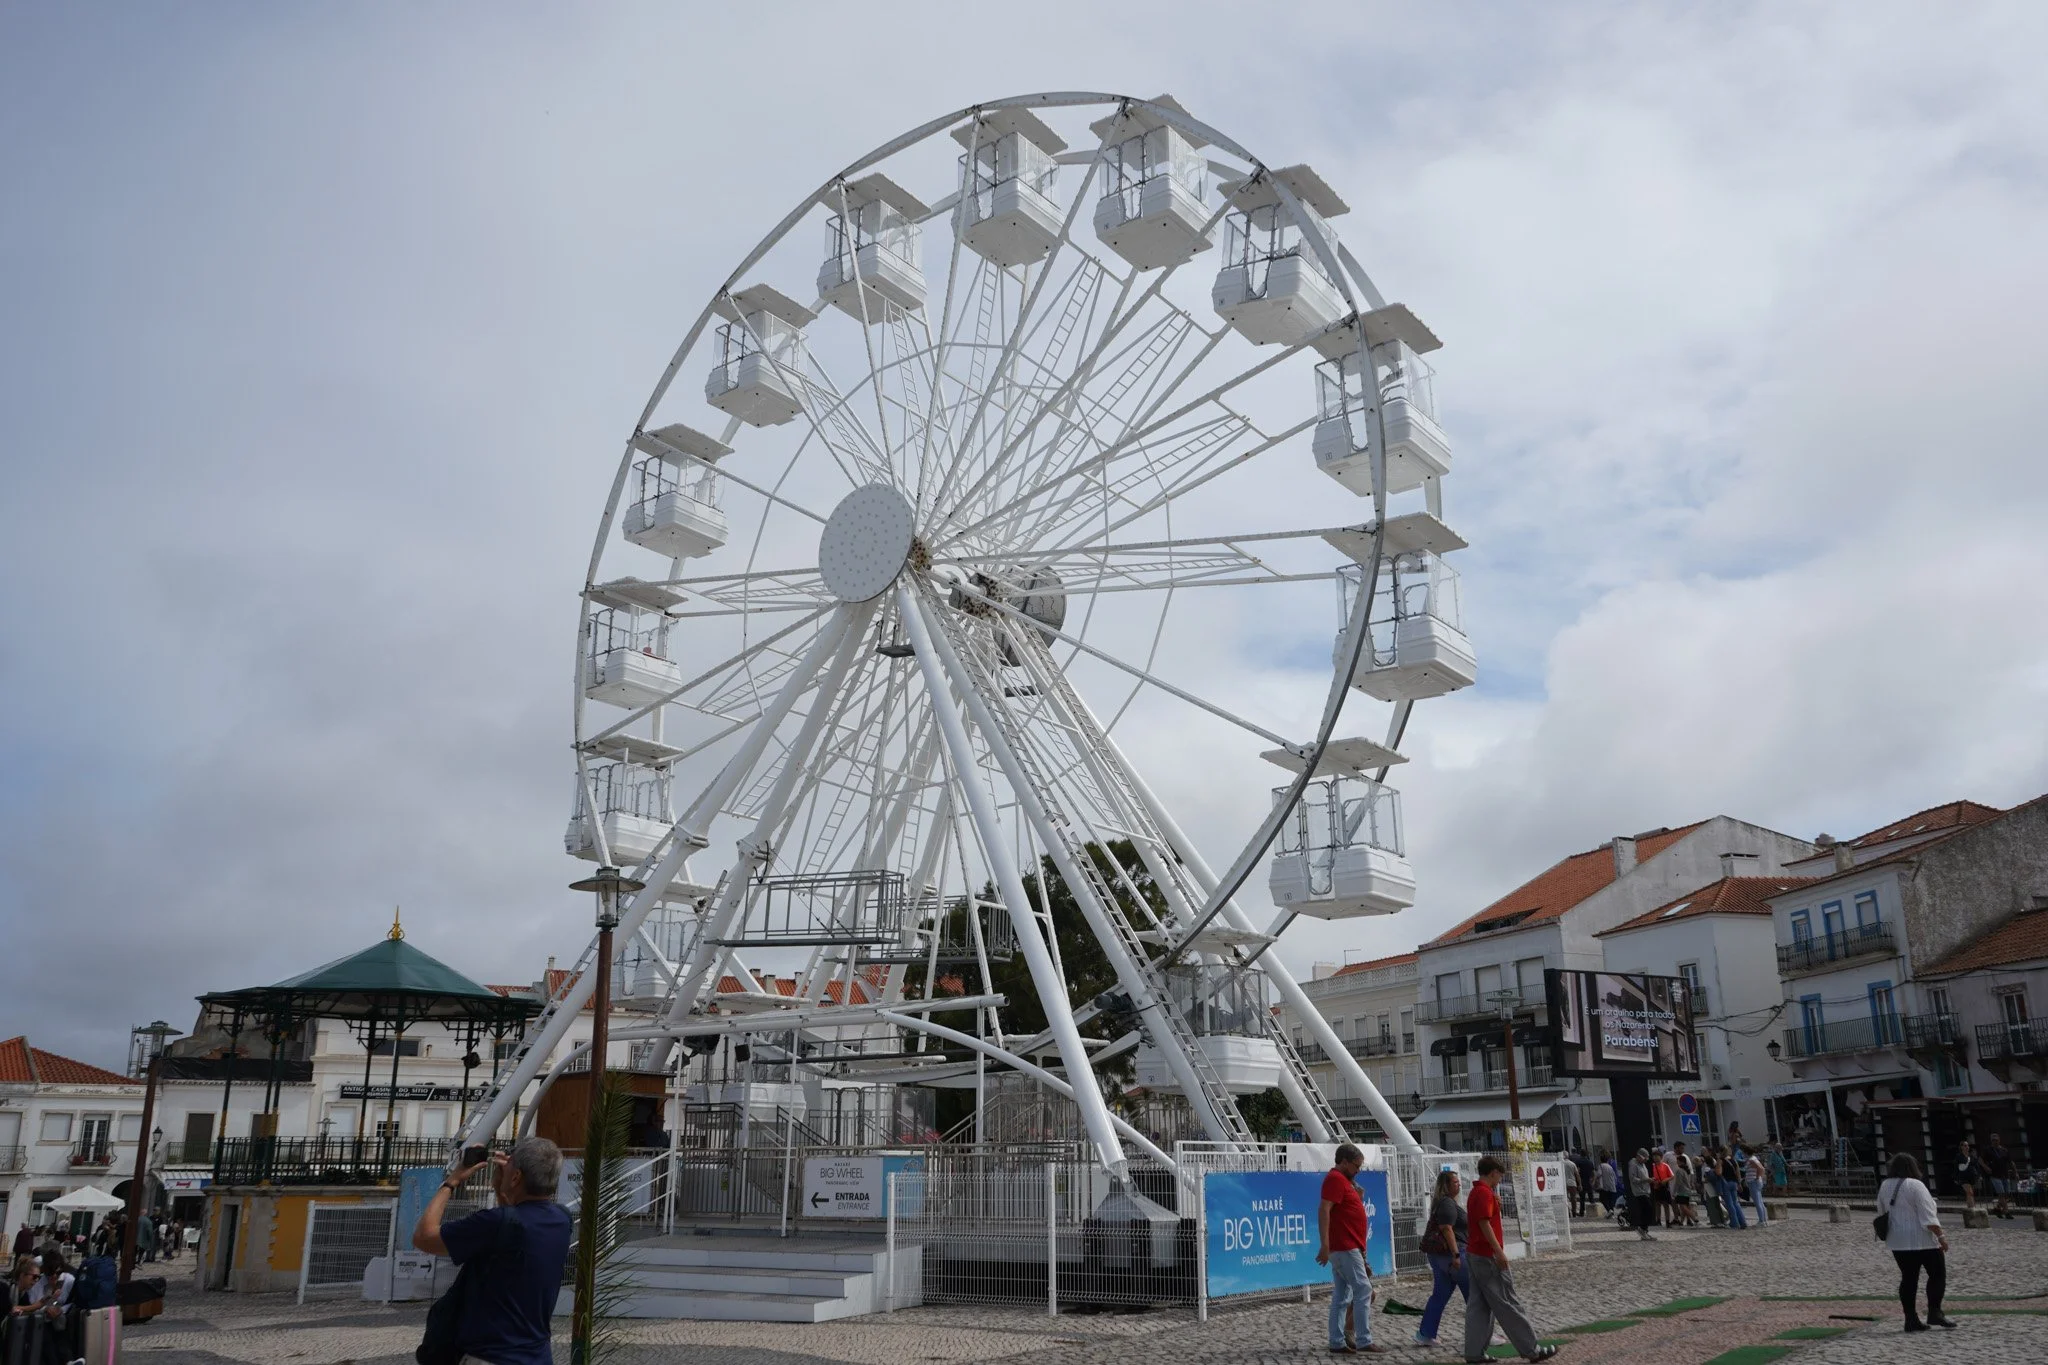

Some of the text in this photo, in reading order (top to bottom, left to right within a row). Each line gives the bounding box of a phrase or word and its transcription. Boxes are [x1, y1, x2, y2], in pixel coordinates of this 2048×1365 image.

[1584, 1005, 1676, 1020] É um orgulho para todos
[1616, 1020, 1656, 1030] Nazarenos
[1604, 1034, 1659, 1048] Parabéns!
[820, 1167, 865, 1179] BIG WHEEL
[835, 1192, 870, 1201] ENTRADA
[837, 1202, 870, 1211] ENTRANCE
[1252, 1196, 1284, 1212] NAZARÉ
[1224, 1214, 1311, 1251] BIG WHEEL
[1242, 1251, 1297, 1266] PANORAMIC VIEW
